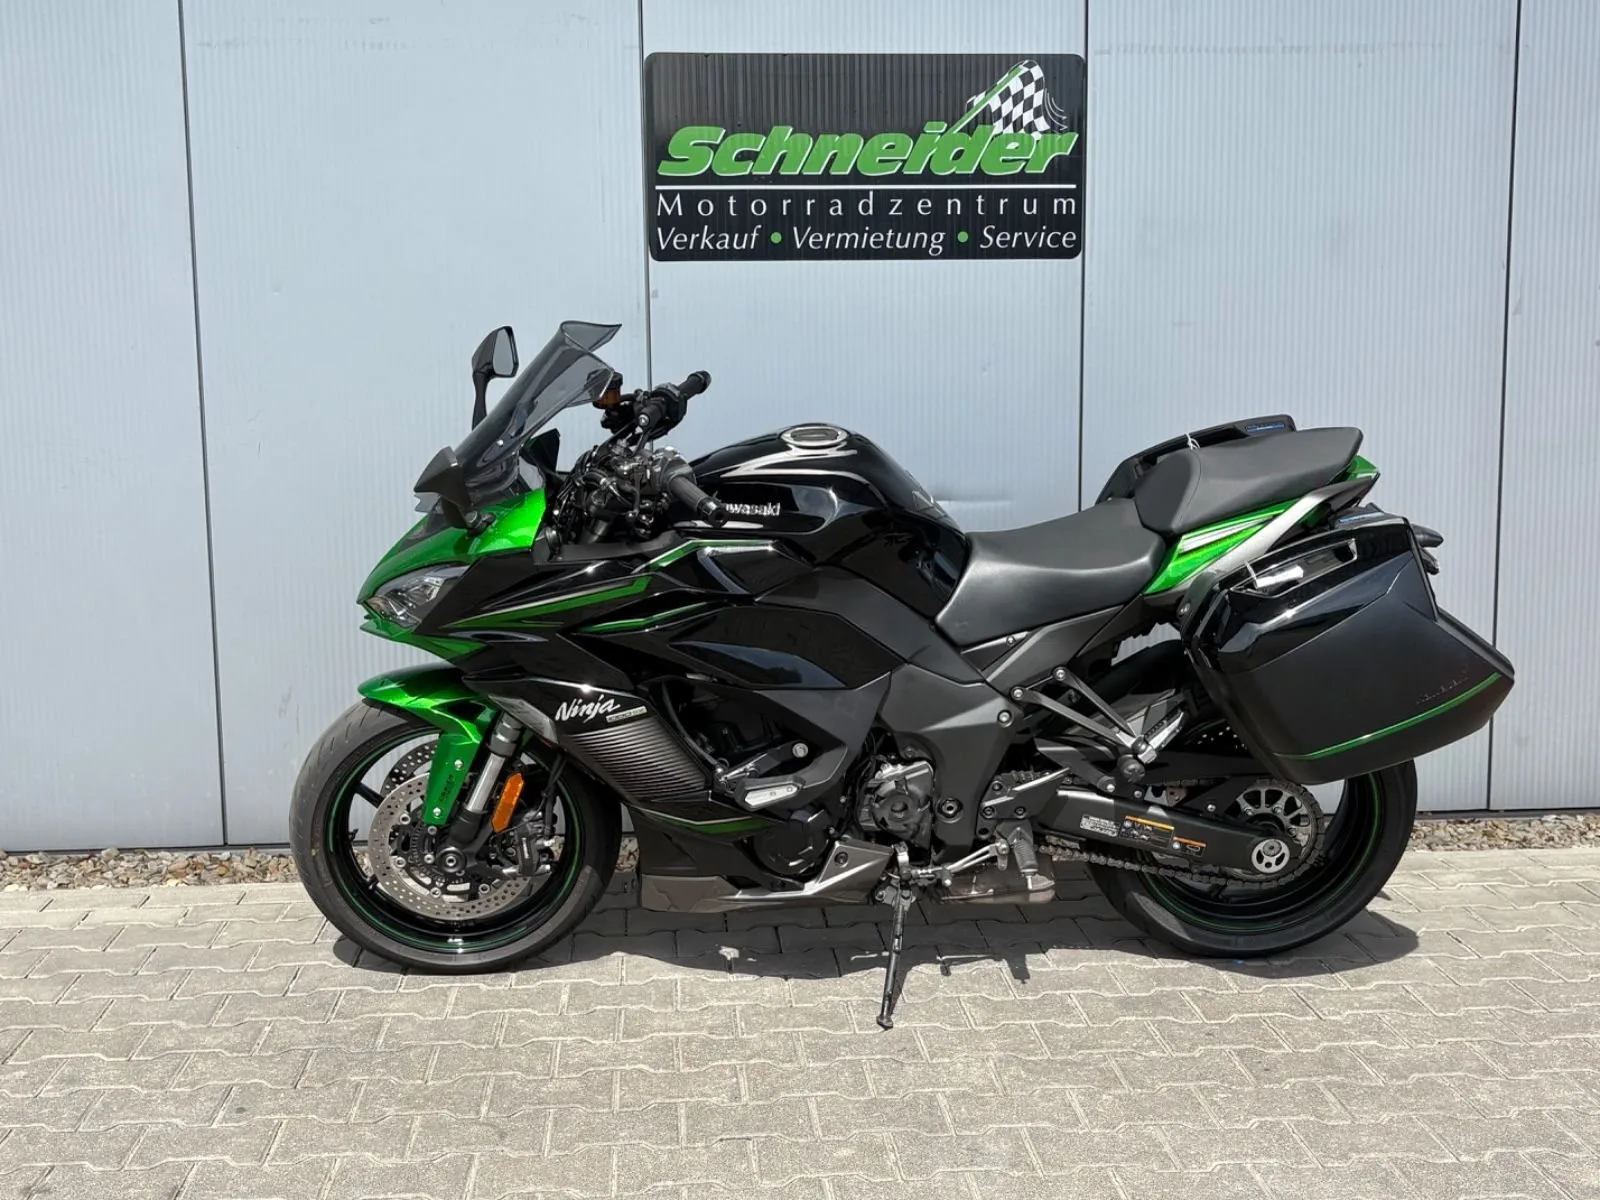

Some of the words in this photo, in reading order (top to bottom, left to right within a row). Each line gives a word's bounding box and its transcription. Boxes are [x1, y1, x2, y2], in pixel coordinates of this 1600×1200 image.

[657, 120, 1079, 177] Schneider
[656, 190, 1077, 217] Motorradzentrum
[656, 224, 762, 251] Verkauf
[792, 225, 946, 256] Vermietung
[979, 224, 1078, 250] Service
[554, 694, 622, 724] Ninja
